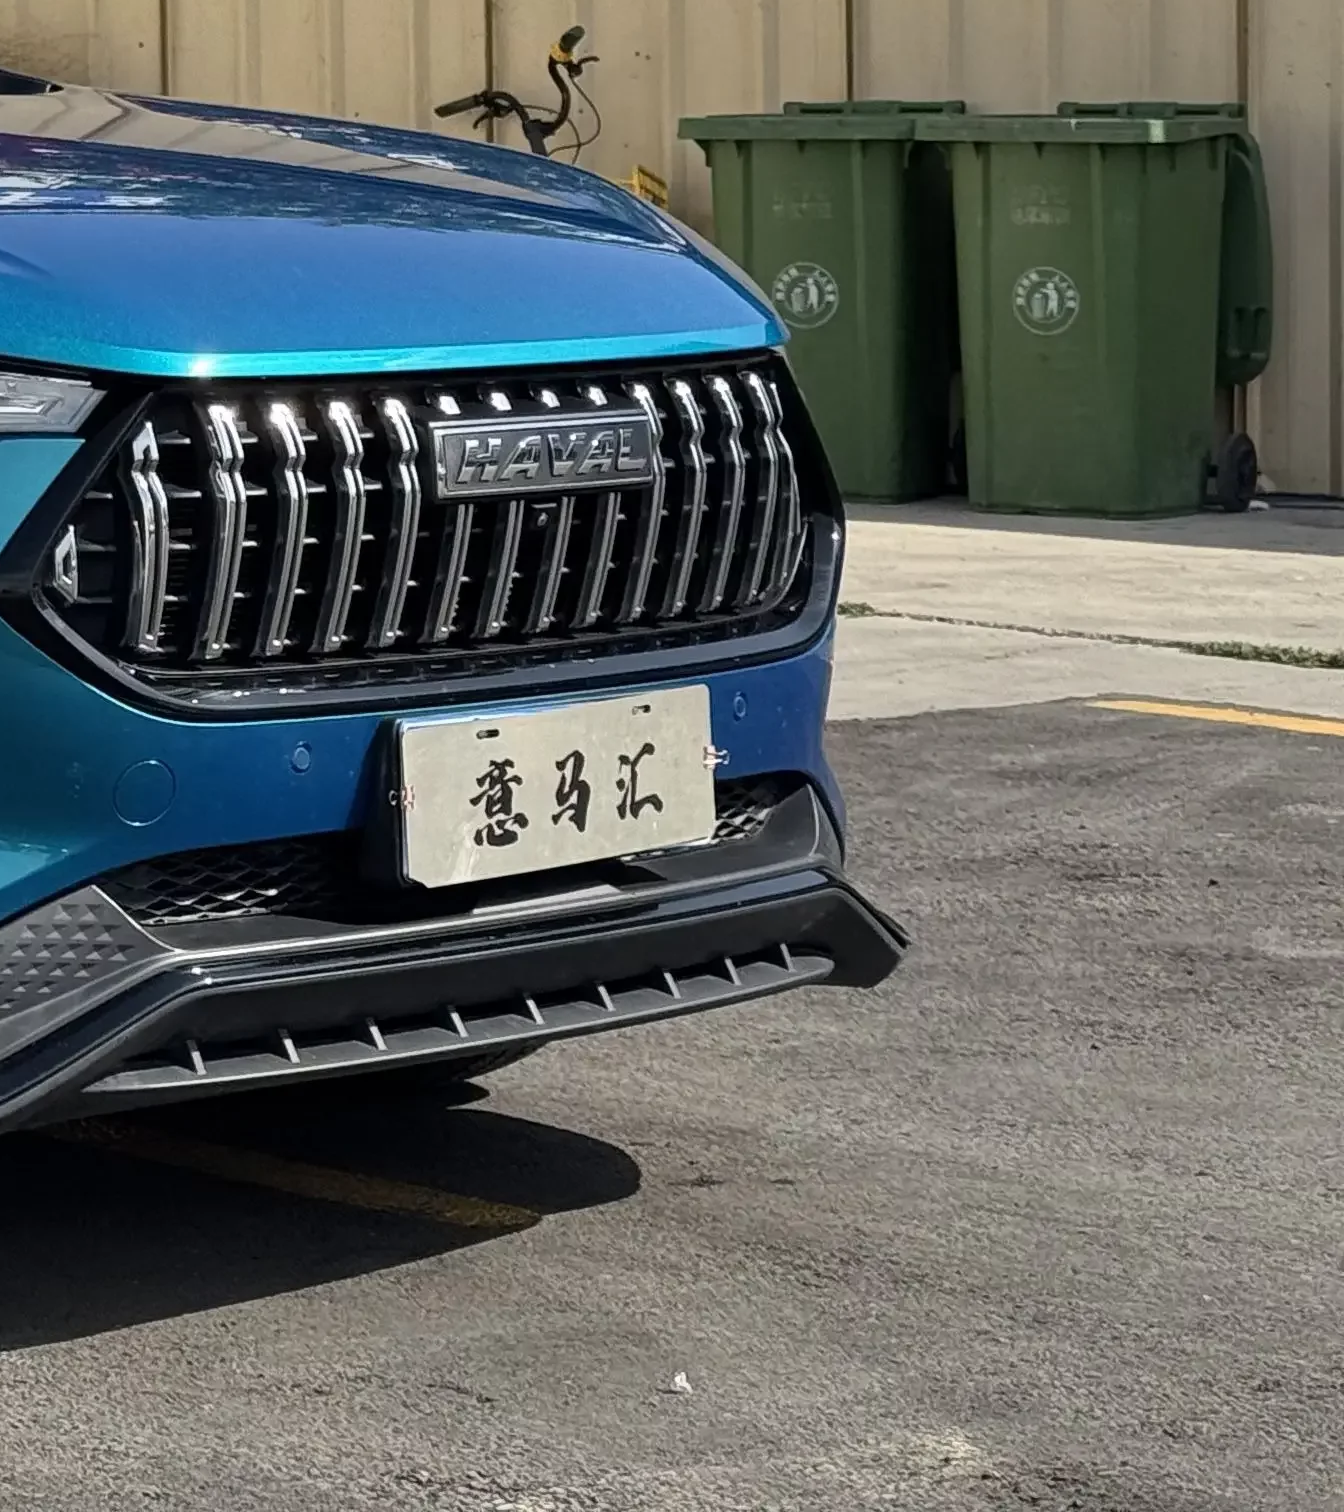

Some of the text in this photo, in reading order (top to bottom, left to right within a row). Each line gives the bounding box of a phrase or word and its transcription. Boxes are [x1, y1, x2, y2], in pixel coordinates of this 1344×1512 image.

[454, 426, 648, 485] HAVAL
[469, 742, 664, 848] 意马汇
